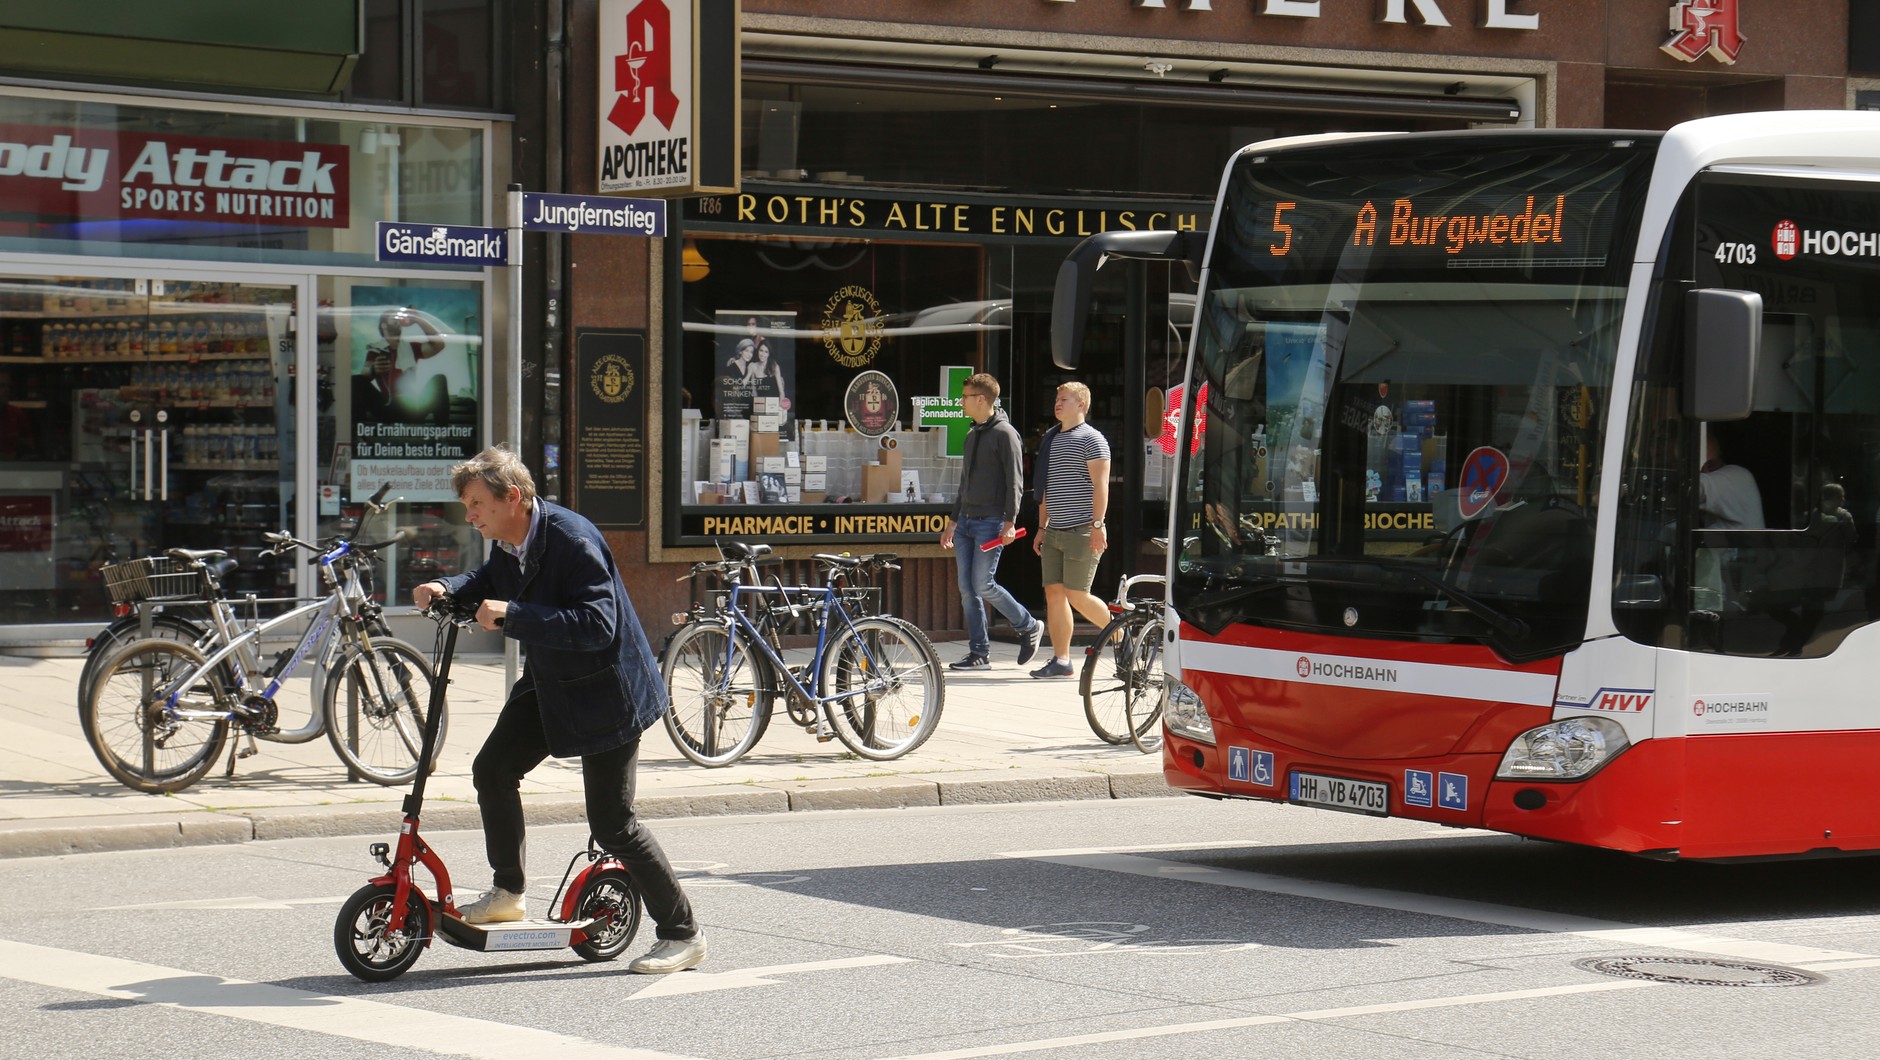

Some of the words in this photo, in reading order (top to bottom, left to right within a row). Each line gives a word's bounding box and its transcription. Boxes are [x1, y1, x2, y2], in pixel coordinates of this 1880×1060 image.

[121, 141, 338, 194] Attack
[601, 137, 687, 181] APOTHEKE
[121, 186, 206, 213] SPORTS
[216, 194, 335, 220] NUTRITION
[533, 199, 656, 235] Jungfernstieg
[738, 194, 866, 227] ROTH'S
[885, 202, 970, 232] ALTE
[1270, 202, 1297, 256] 5
[1353, 200, 1378, 246] A
[1389, 194, 1566, 255] Burgwedel
[385, 227, 502, 259] Gänsemarkt
[1714, 242, 1757, 265] 4703
[1803, 230, 1880, 257] HOCH
[911, 397, 939, 408] Täglich
[941, 398, 953, 407] bis
[920, 409, 964, 418] Sonnabend
[357, 422, 375, 437] Der
[377, 422, 473, 440] Ernährungspartner
[356, 442, 373, 457] für
[374, 442, 403, 457] Deine
[405, 442, 433, 457] beste
[435, 442, 465, 457] Form.
[357, 464, 368, 477] Ob
[370, 464, 426, 477] Muskelaufbau
[427, 464, 445, 477] oder
[357, 478, 376, 491] alles
[414, 478, 434, 491] Ziele
[703, 516, 813, 535] PHARMACIE
[1364, 512, 1434, 530] BIOCHE
[1313, 662, 1397, 683] HOCHBAHN
[1599, 694, 1651, 713] HVV
[1706, 701, 1768, 713] HOCHBAHN
[1300, 777, 1317, 800] HH
[1328, 780, 1346, 803] YB
[1349, 784, 1384, 809] 4703
[503, 931, 556, 941] evectro.com
